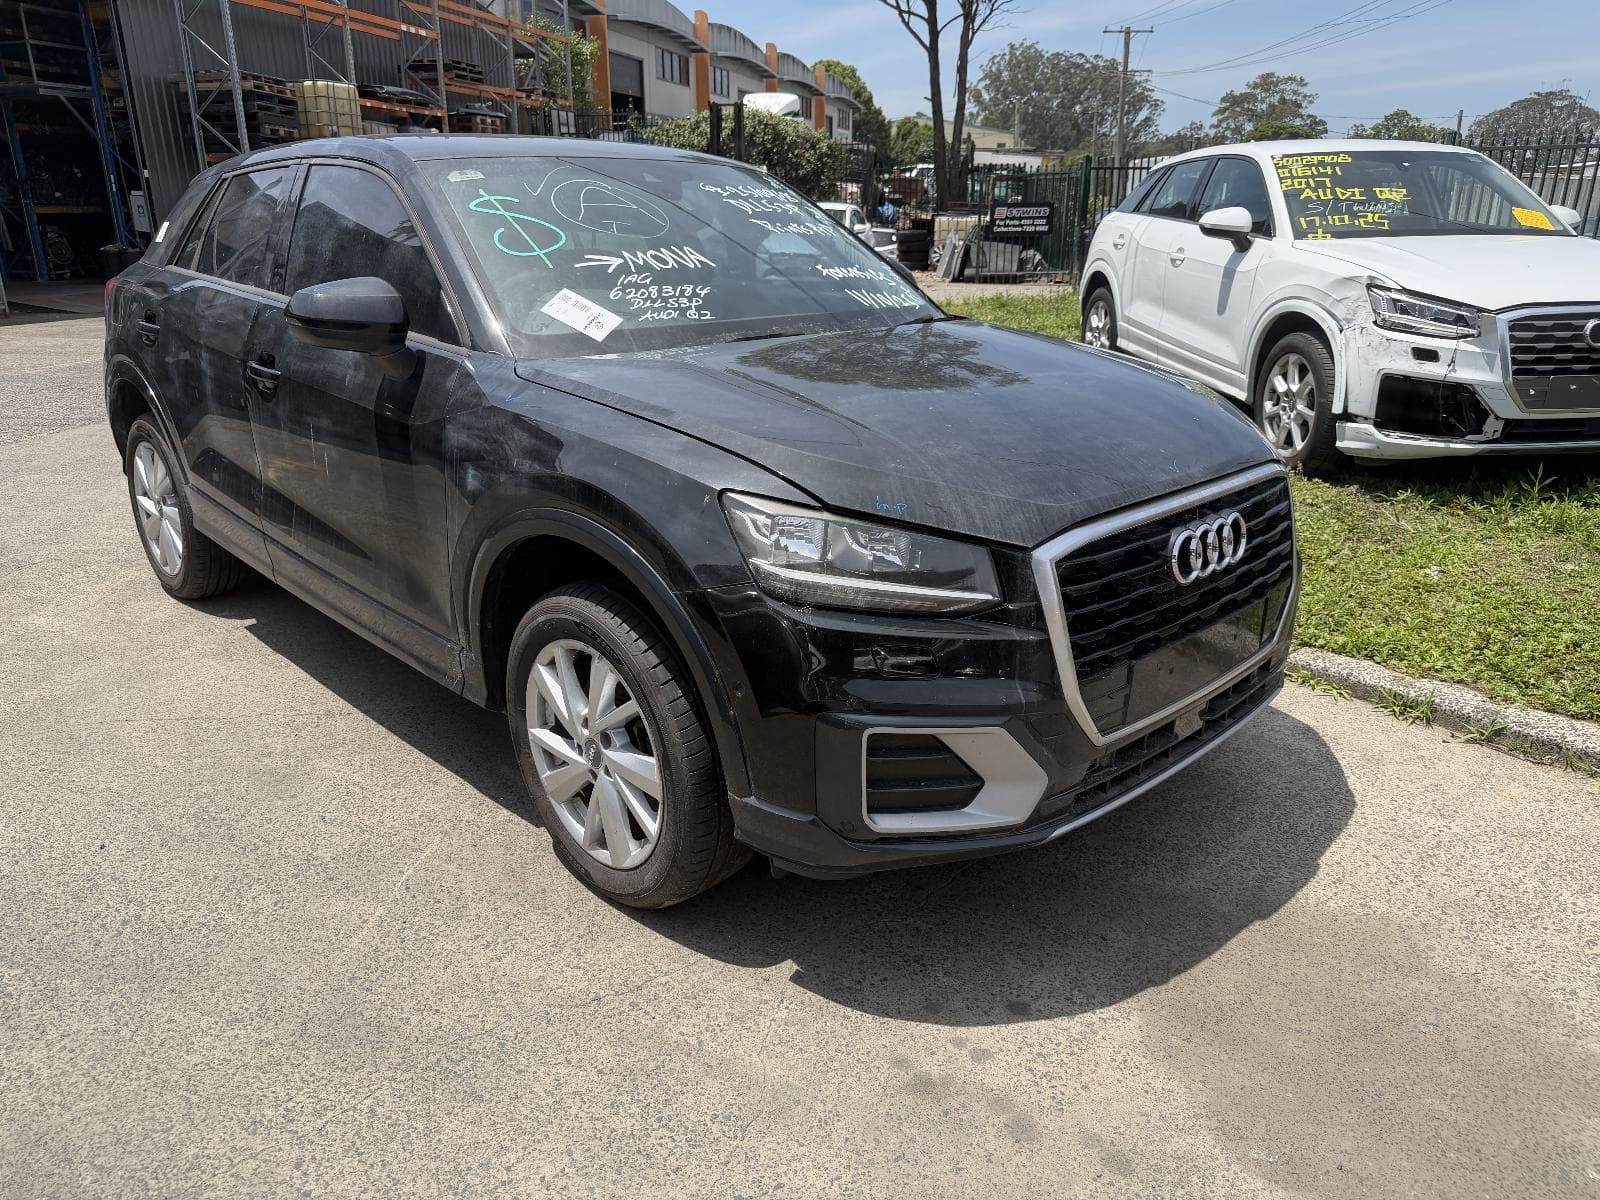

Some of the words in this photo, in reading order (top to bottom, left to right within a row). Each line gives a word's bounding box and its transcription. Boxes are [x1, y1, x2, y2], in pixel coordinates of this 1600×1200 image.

[1280, 177, 1332, 191] 2017
[1300, 187, 1366, 200] AUDI
[1299, 213, 1390, 229] 17.10.25
[621, 245, 717, 273] MONA
[609, 284, 712, 300] 62083184
[638, 309, 679, 322] AUDI
[686, 309, 717, 320] Q2
